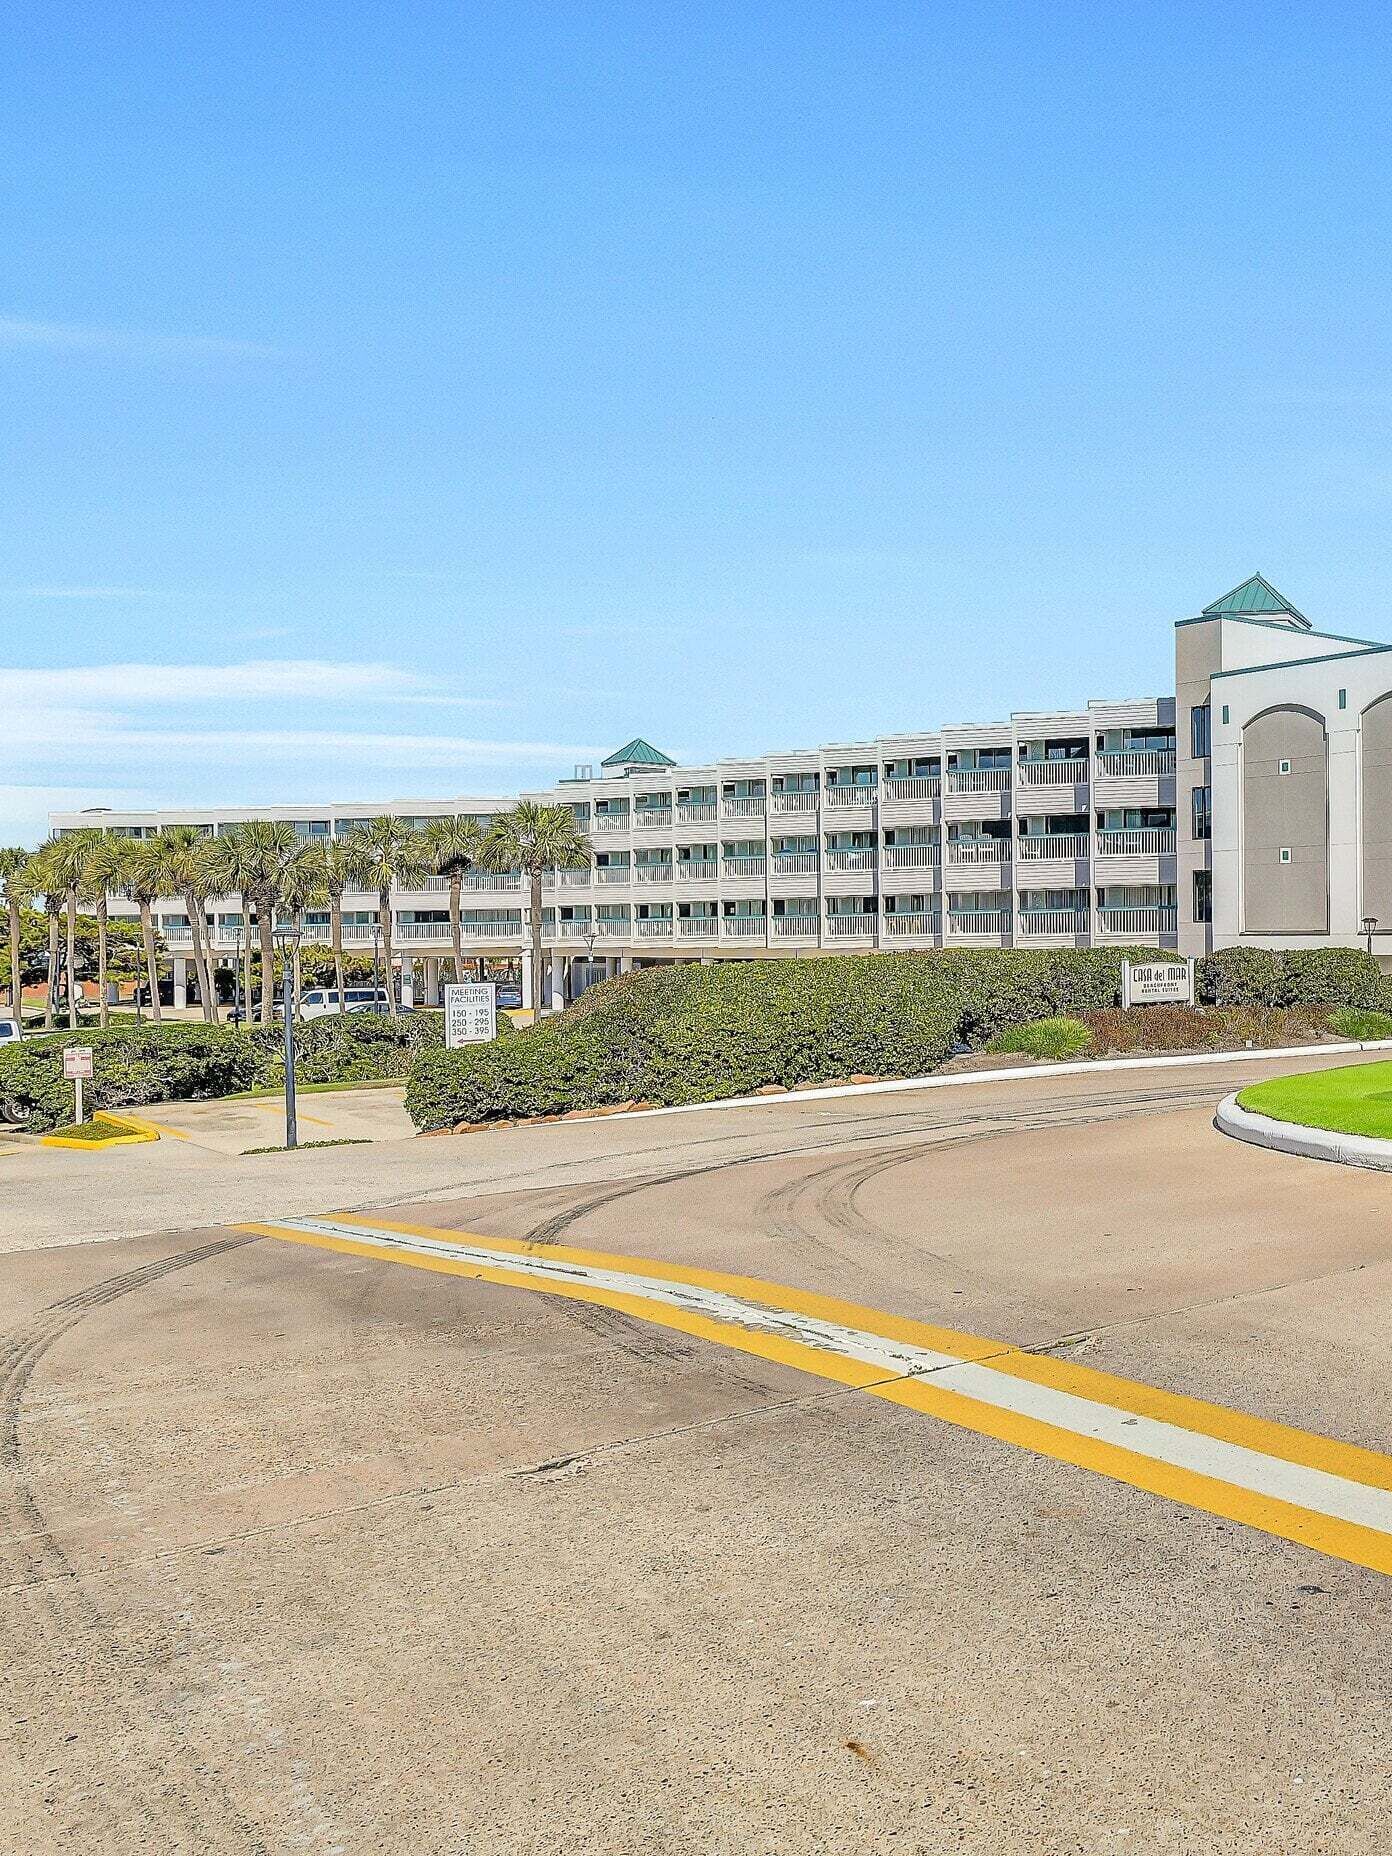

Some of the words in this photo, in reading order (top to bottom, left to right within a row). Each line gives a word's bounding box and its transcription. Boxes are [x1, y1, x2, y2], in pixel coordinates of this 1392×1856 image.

[1133, 968, 1152, 982] CASA
[1154, 969, 1165, 981] del
[1167, 967, 1187, 981] MAR
[451, 988, 488, 996] MEETING
[450, 995, 490, 1004] FACILITIES
[452, 1009, 467, 1018] 150
[475, 1008, 489, 1017] 195
[451, 1018, 467, 1027] 250
[474, 1017, 490, 1026] 295
[451, 1027, 467, 1036] 350
[474, 1026, 490, 1035] 395
